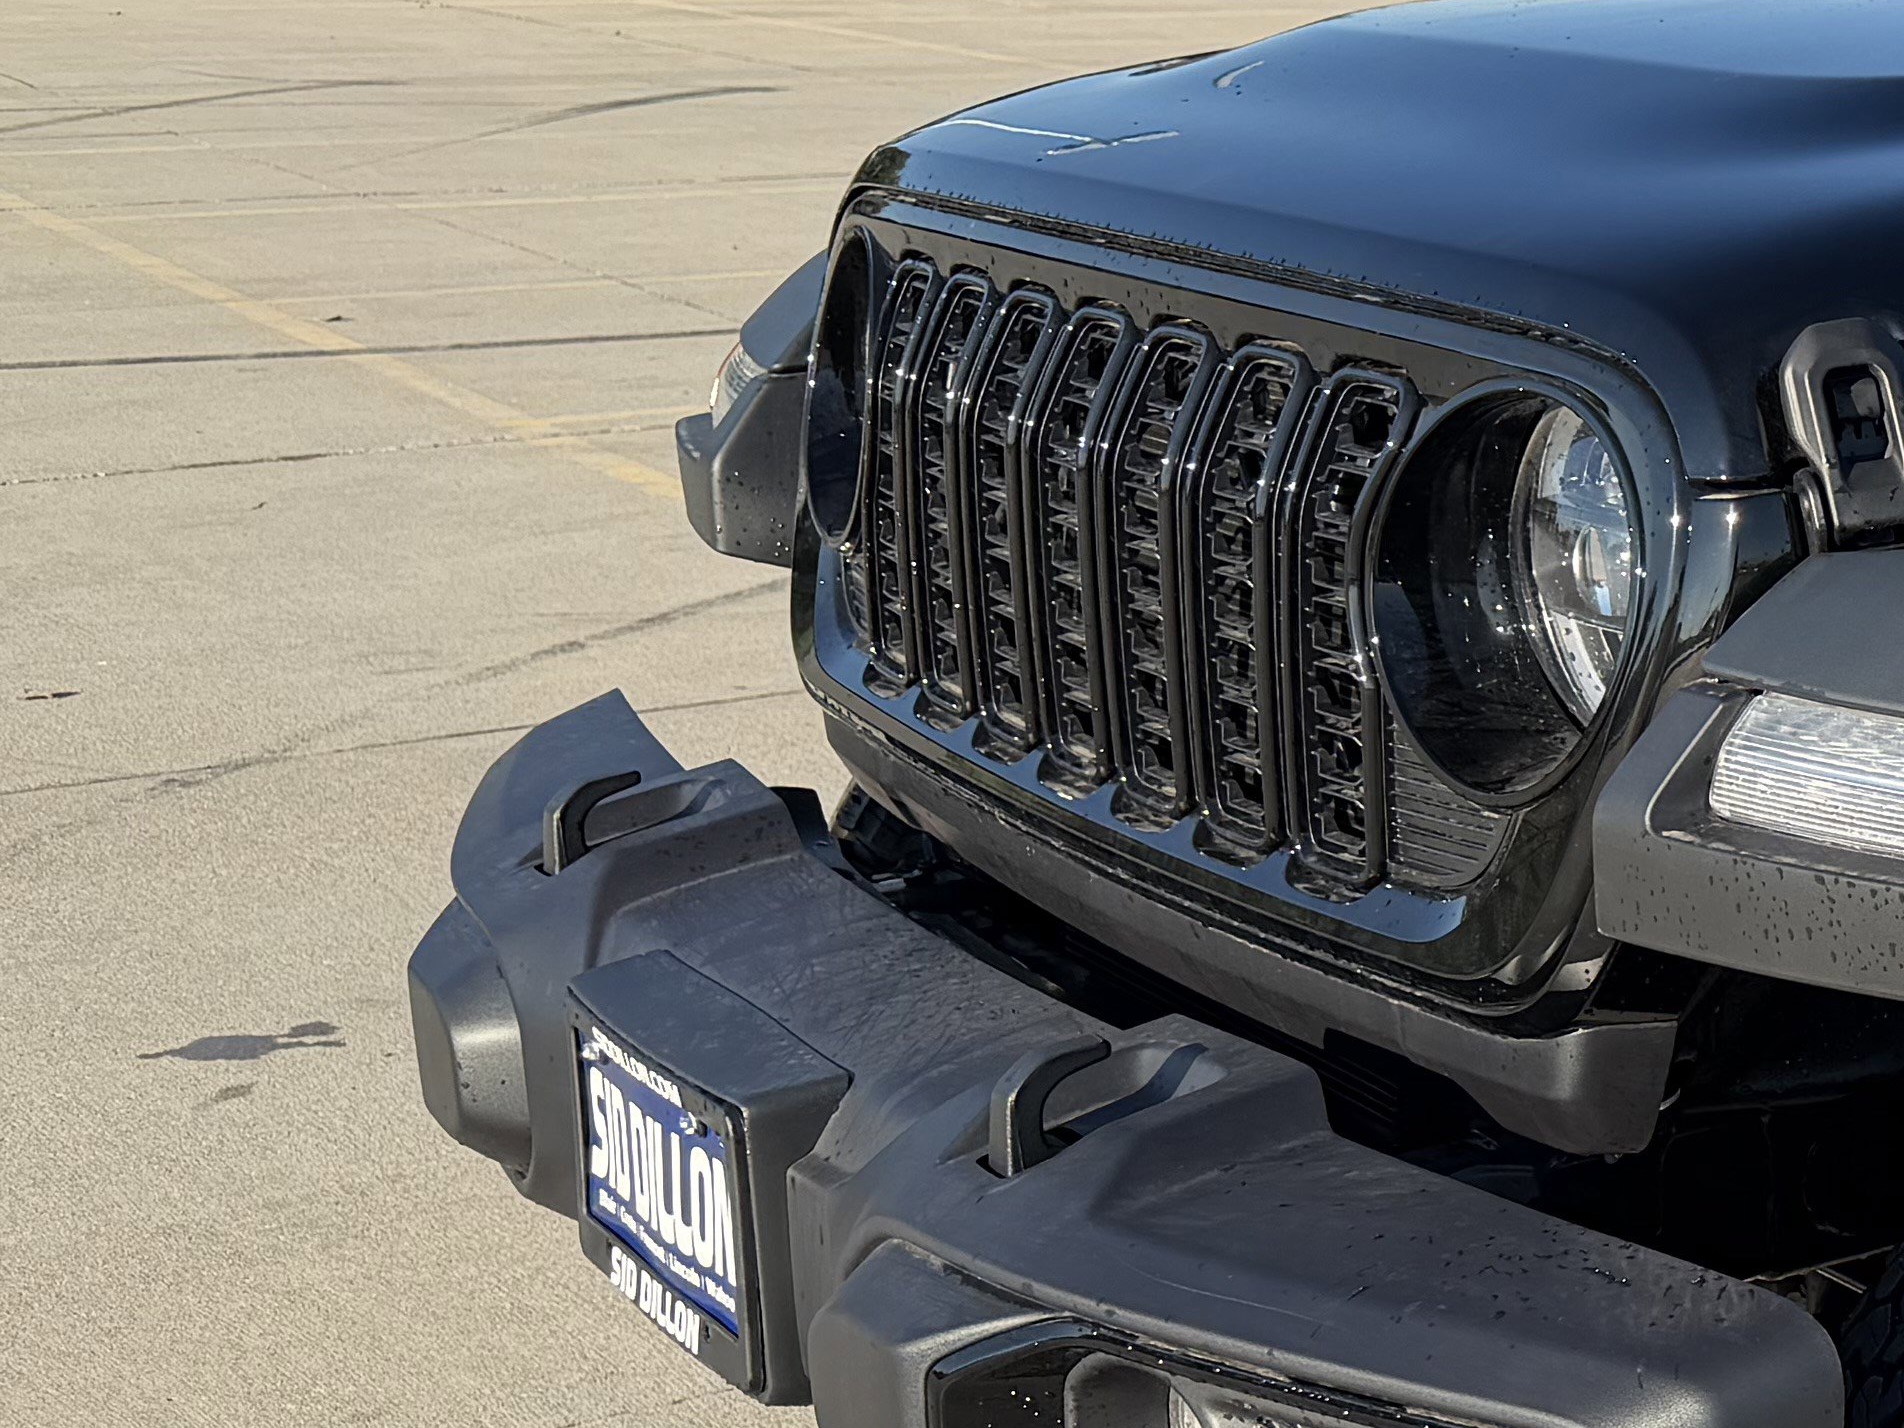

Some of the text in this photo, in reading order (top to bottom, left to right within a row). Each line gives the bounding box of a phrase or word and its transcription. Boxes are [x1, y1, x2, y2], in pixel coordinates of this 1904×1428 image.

[589, 1066, 737, 1287] SID DILLON
[610, 1245, 700, 1355] SID DILLON
